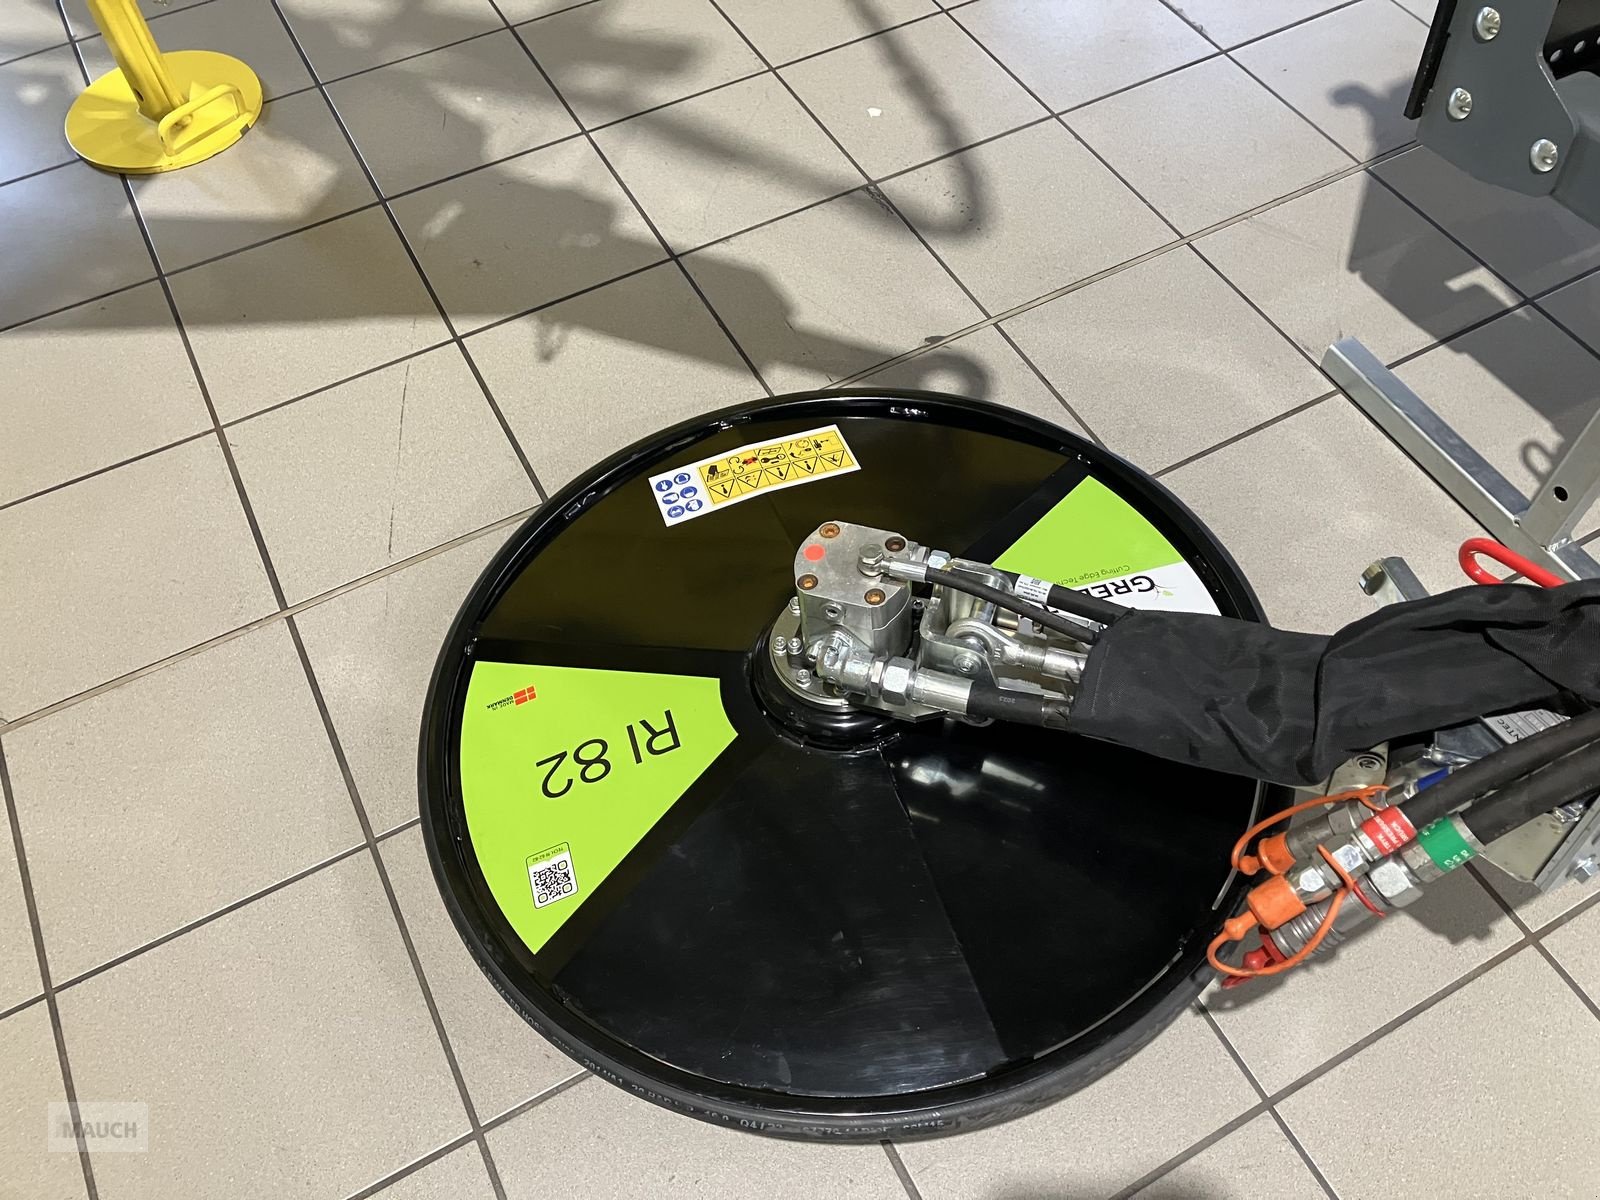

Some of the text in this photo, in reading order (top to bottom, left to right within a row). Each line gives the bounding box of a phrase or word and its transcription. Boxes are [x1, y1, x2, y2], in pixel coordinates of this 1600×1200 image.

[1079, 571, 1100, 580] Edge
[1101, 564, 1131, 576] Cutting
[486, 695, 514, 709] DENMARK
[535, 709, 681, 799] RI 82
